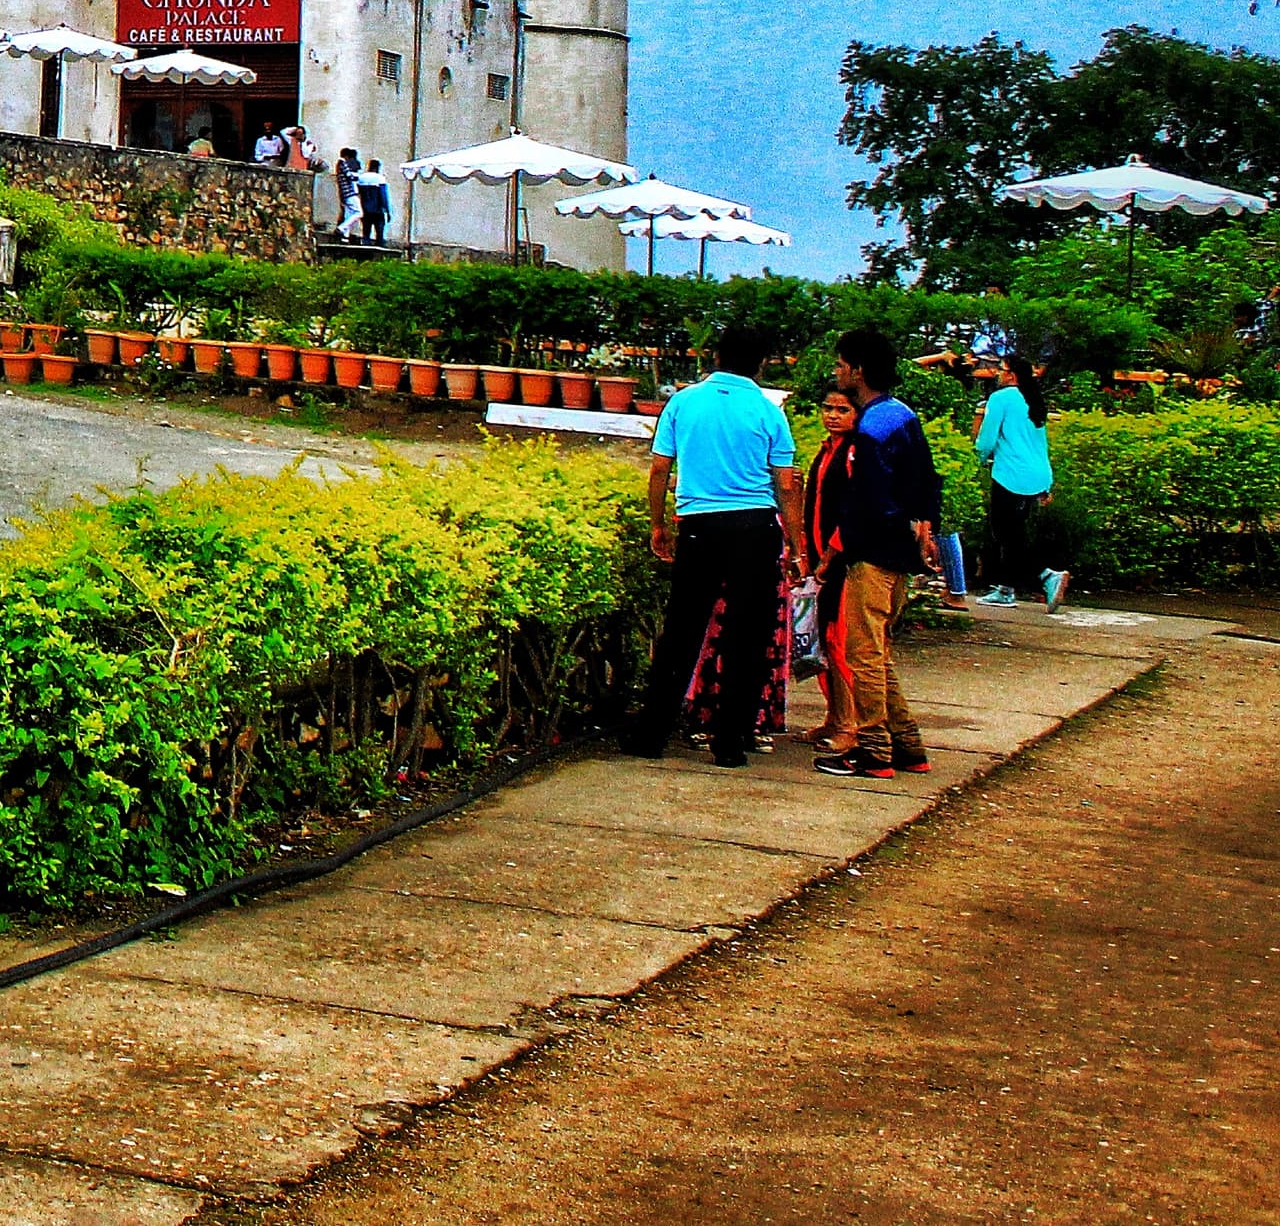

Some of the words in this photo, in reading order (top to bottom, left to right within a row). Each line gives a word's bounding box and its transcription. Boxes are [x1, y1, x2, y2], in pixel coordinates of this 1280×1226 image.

[166, 10, 246, 25] PALACE
[130, 26, 166, 42] CAFÉ
[171, 30, 180, 42] &
[186, 28, 284, 42] RESTAURANT
